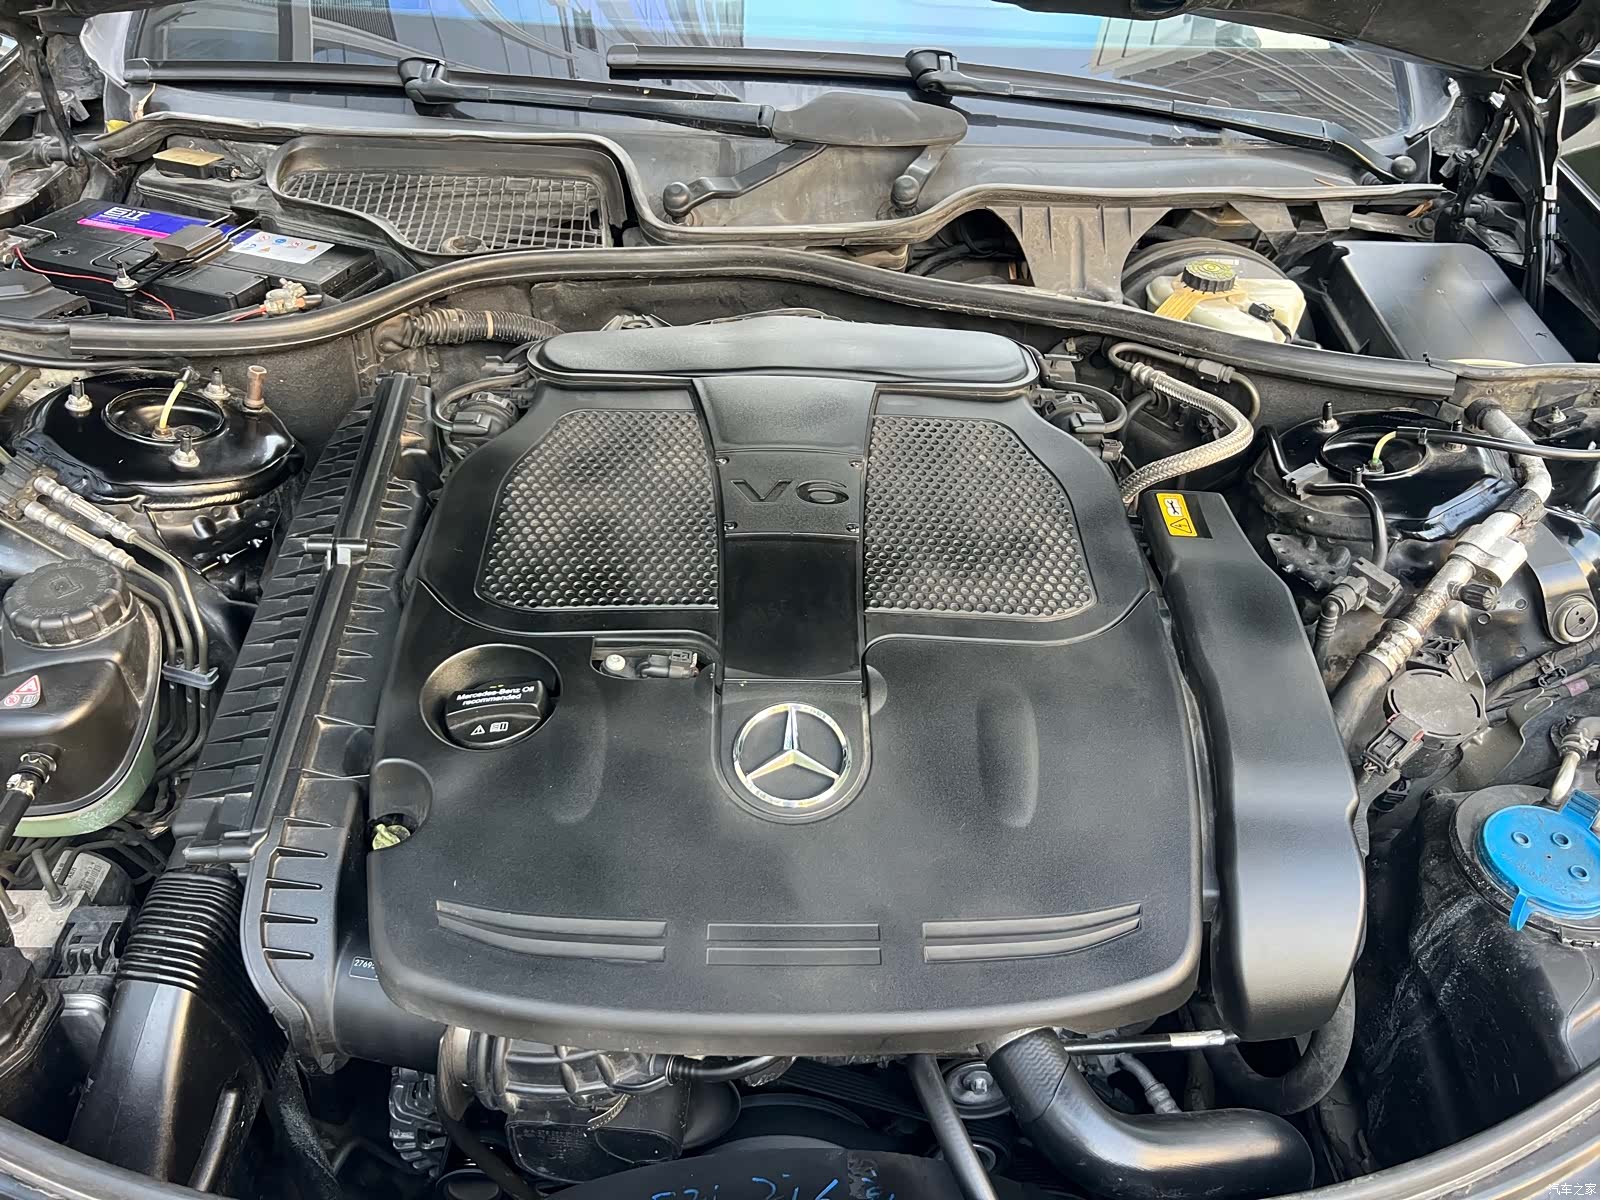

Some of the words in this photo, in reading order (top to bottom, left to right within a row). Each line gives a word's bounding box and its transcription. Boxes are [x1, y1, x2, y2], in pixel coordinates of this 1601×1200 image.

[731, 479, 849, 505] V6
[456, 687, 521, 701] Mercedes-Benz
[522, 685, 535, 693] Oil
[462, 693, 522, 706] recommended
